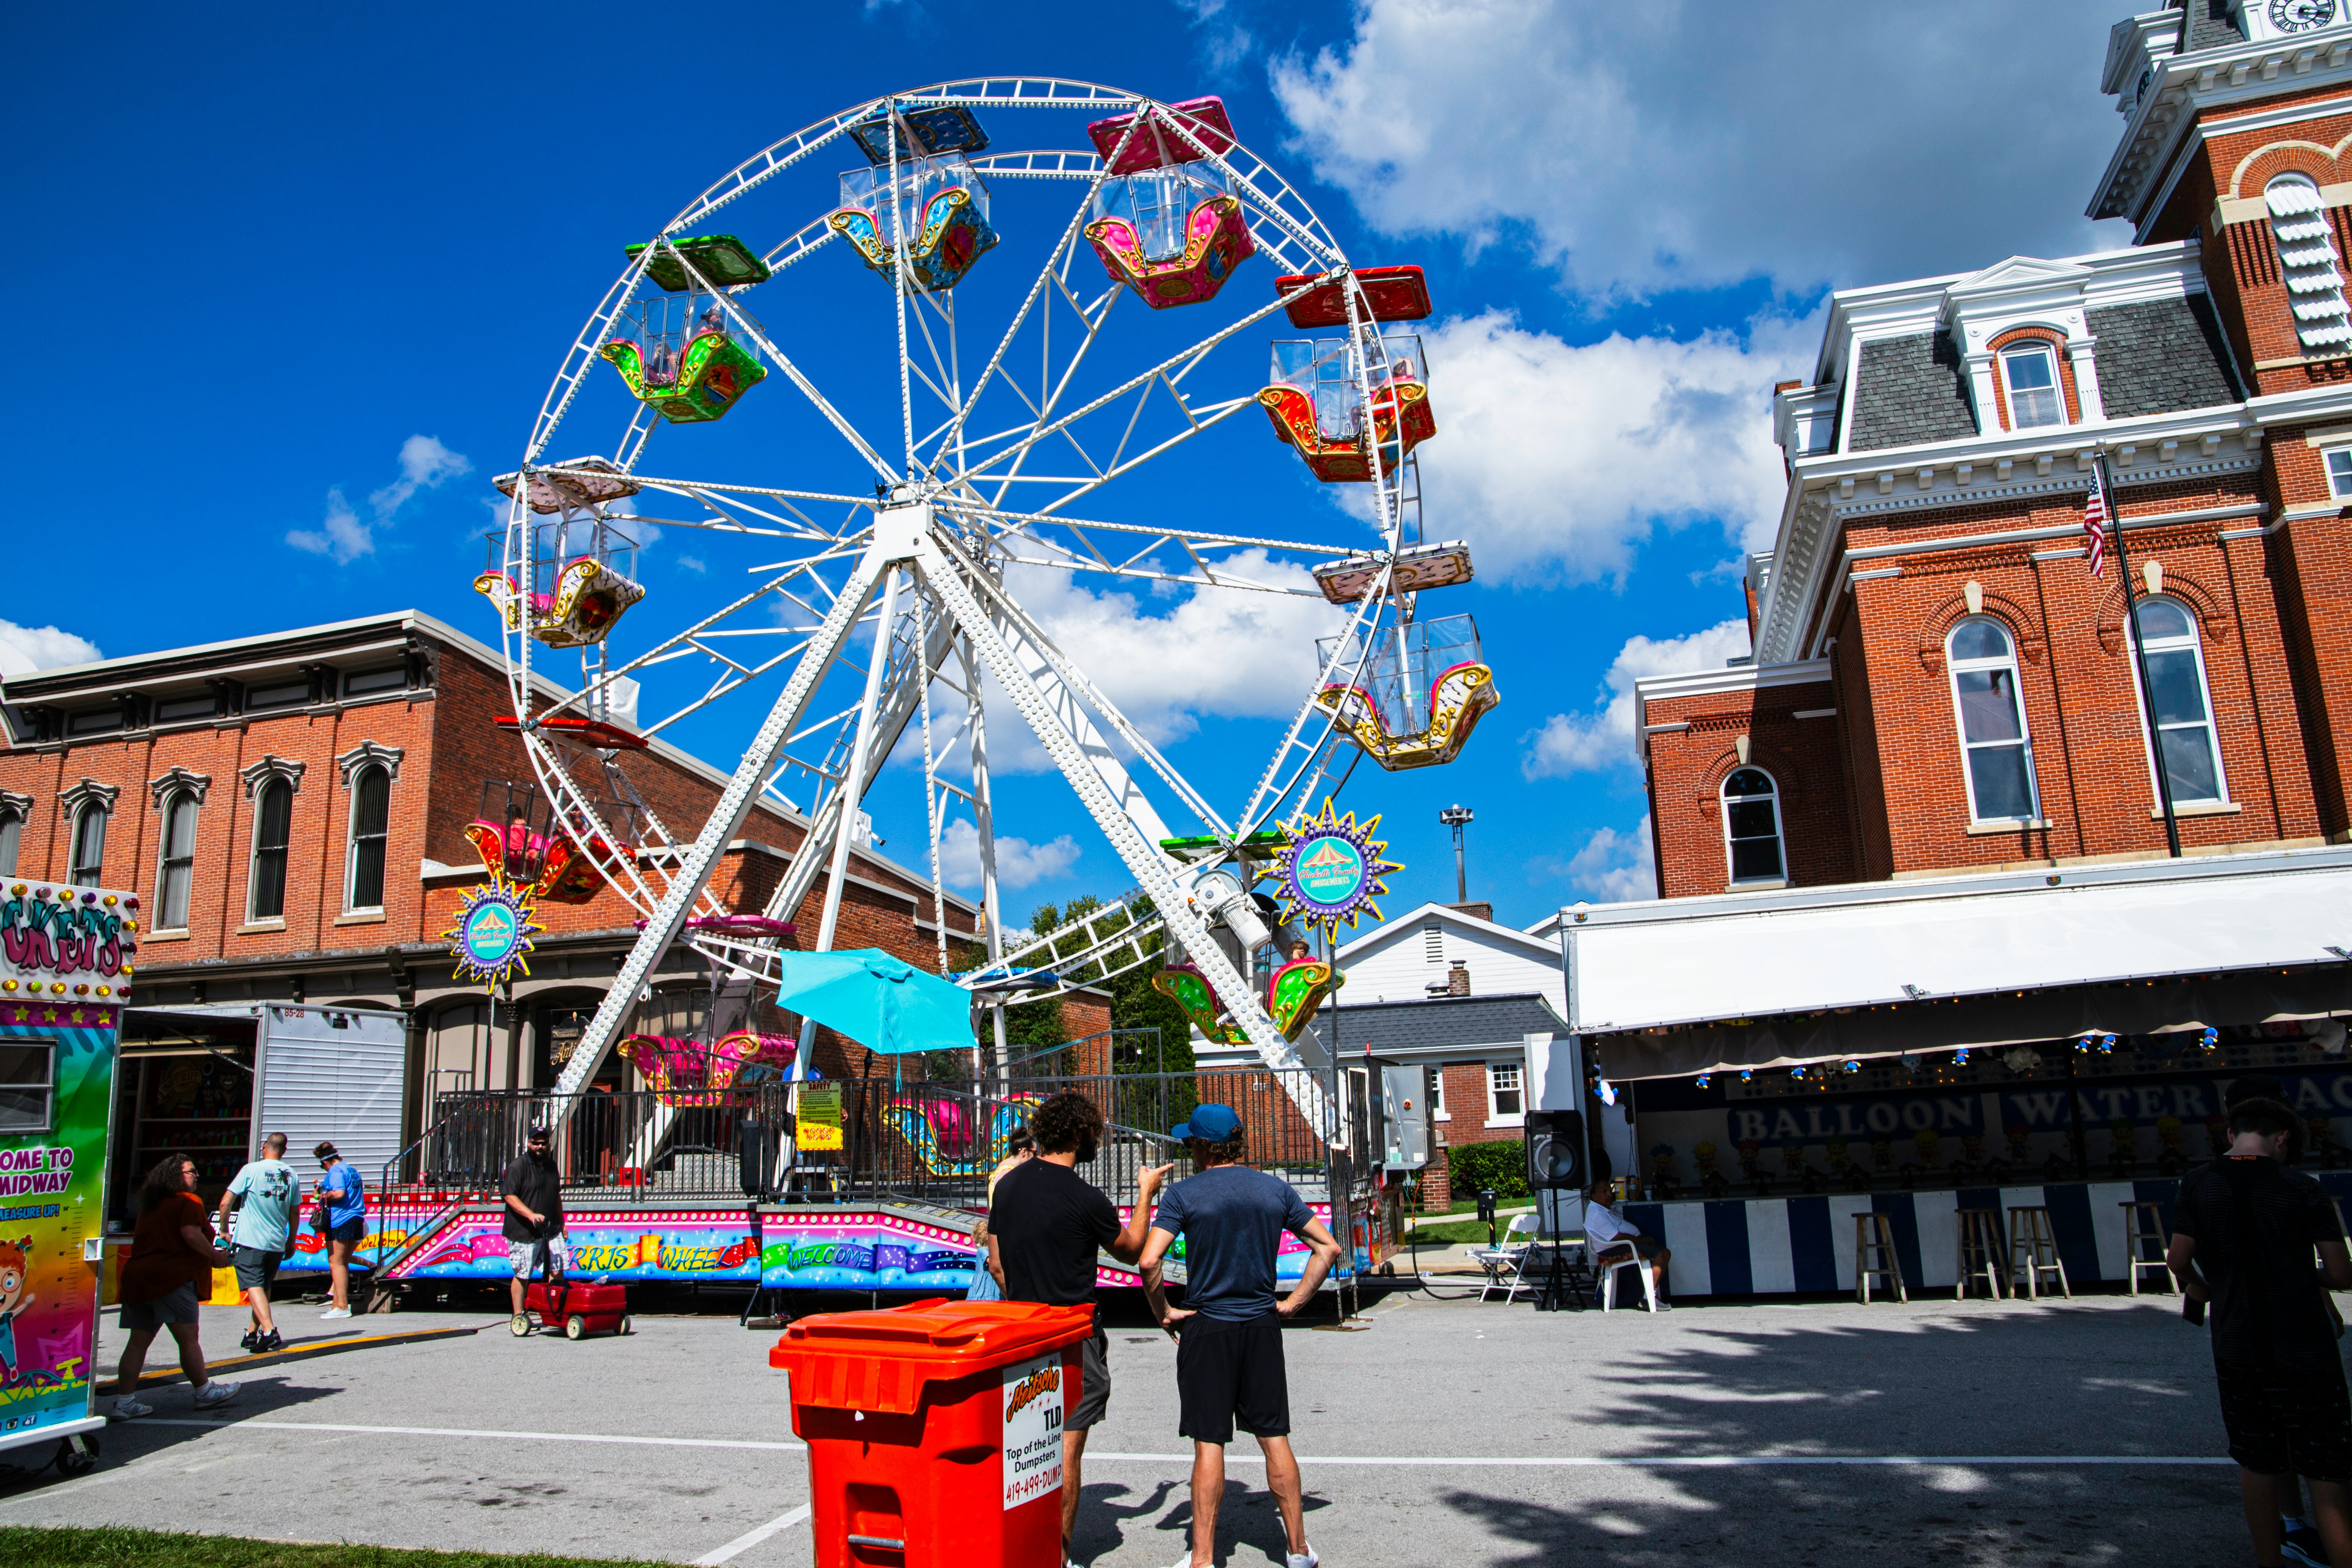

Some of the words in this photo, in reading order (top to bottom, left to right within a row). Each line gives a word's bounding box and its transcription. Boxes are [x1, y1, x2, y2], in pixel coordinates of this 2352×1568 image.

[1299, 868, 1330, 879] Chicketti
[1332, 864, 1359, 877] Family
[1310, 876, 1350, 888] AMUSEMENTS
[493, 930, 512, 940] Family
[285, 1008, 305, 1018] 85-28
[1735, 1096, 1974, 1141] BALLOON
[2009, 1084, 2210, 1125] WATER
[2295, 1075, 2352, 1111] AC
[48, 1148, 74, 1168] TO
[43, 1204, 60, 1217] UP!
[361, 1236, 401, 1250] Welome
[567, 1246, 628, 1271] RRIS
[658, 1246, 733, 1271] WHEEL
[787, 1246, 873, 1269] WELCOME
[1006, 1360, 1060, 1423] Heitsche
[1044, 1406, 1062, 1432] TLD
[1006, 1449, 1022, 1461] Top
[1024, 1444, 1033, 1455] of
[1034, 1439, 1046, 1451] the
[1047, 1432, 1061, 1447] Line
[1015, 1450, 1056, 1473] Dumpsters
[1006, 1463, 1061, 1503] 419-499-DUMP
